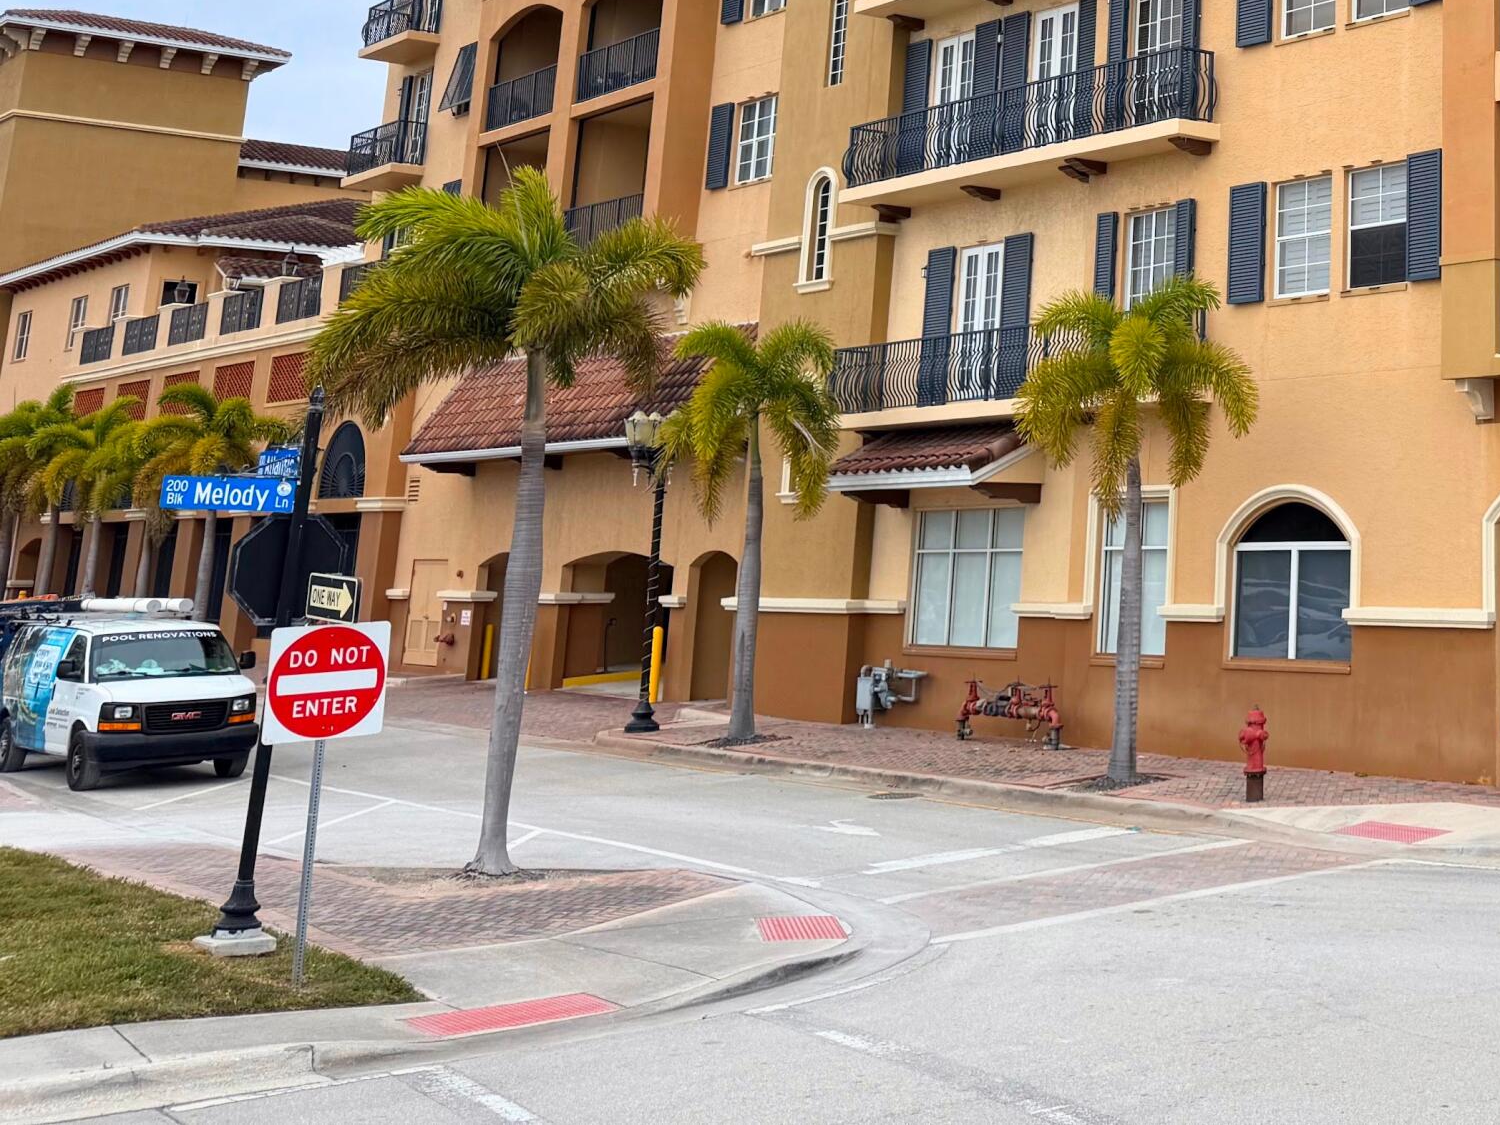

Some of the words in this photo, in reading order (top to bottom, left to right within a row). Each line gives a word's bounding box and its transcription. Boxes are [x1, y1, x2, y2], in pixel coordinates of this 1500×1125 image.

[166, 479, 188, 492] 200
[166, 492, 183, 505] Blk
[193, 481, 270, 511] Melody
[275, 496, 289, 508] Ln
[311, 588, 326, 605] ONE
[326, 590, 341, 607] WAY
[102, 634, 135, 642] POOL
[138, 631, 217, 640] RENOVATIONS
[289, 649, 318, 668] DO
[330, 645, 371, 665] NOT
[292, 696, 358, 718] ENTER
[171, 711, 202, 721] GMC
